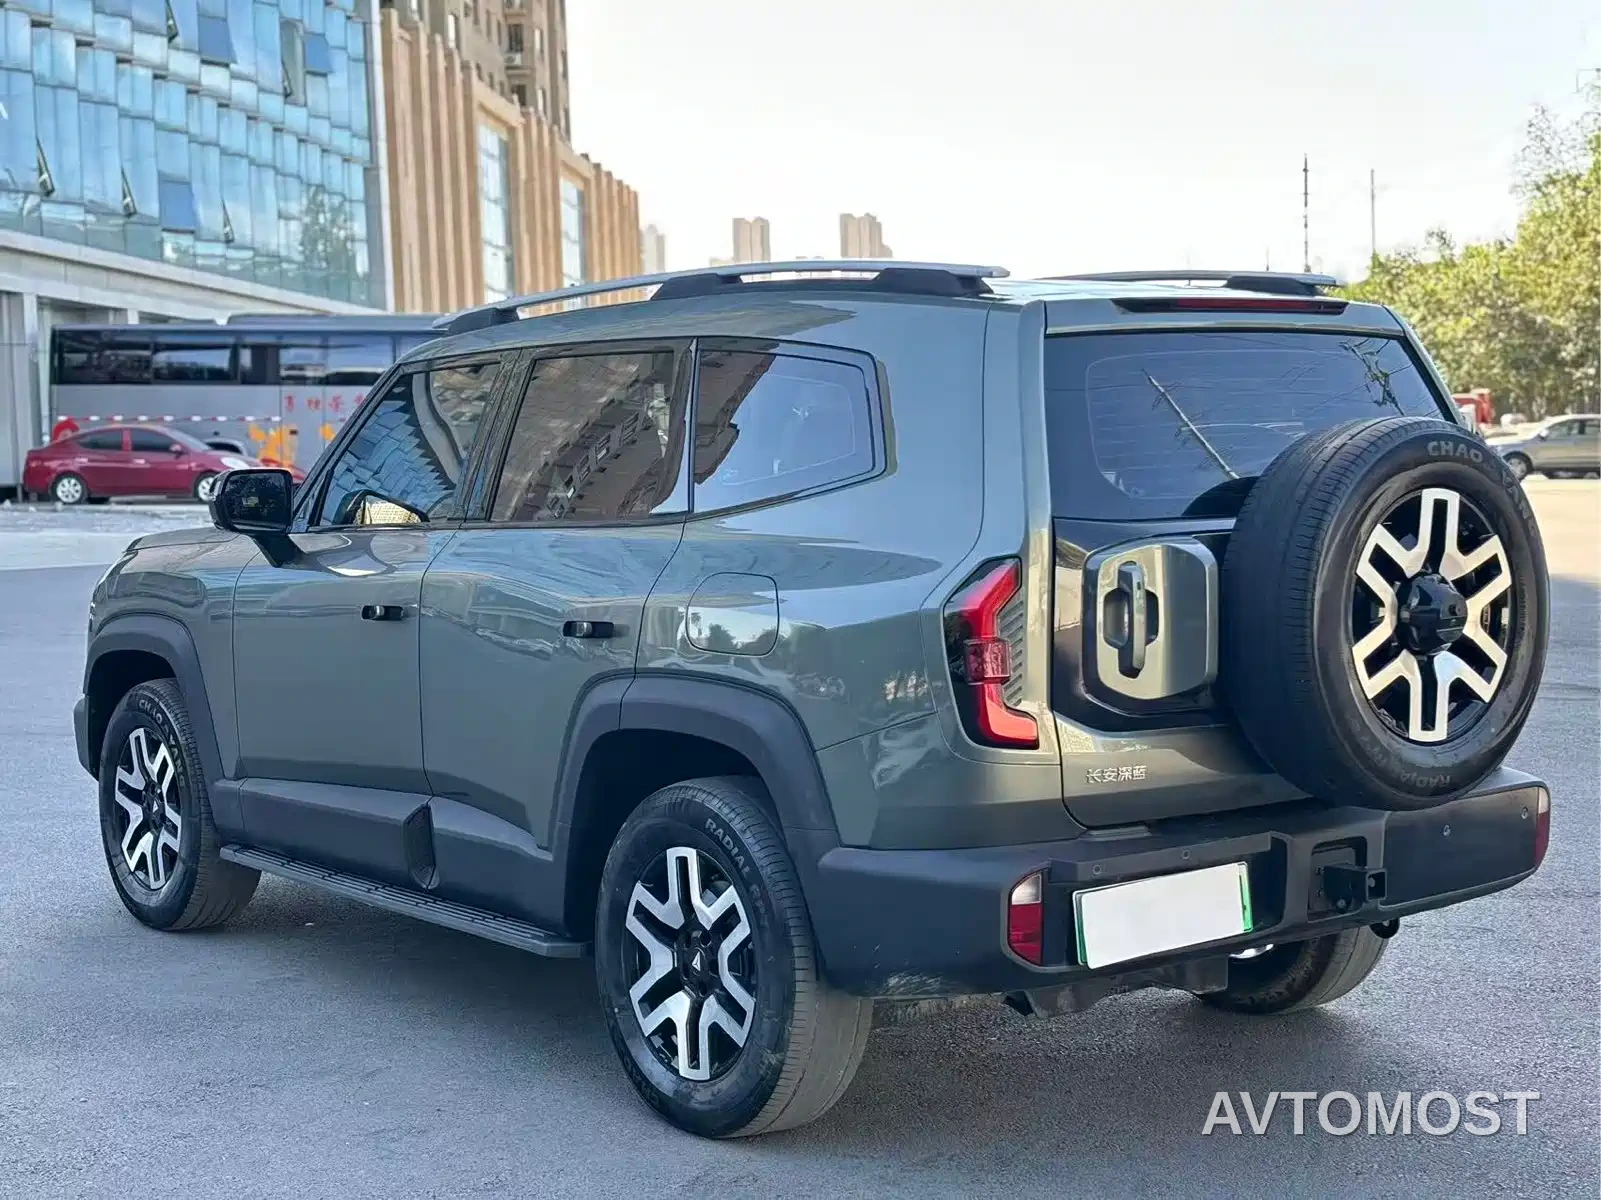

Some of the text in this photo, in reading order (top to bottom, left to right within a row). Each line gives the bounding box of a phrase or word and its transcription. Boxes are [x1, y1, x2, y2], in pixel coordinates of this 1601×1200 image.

[1427, 441, 1483, 462] CHAO
[139, 699, 163, 724] CHAO
[1086, 765, 1147, 783] 长安深蓝
[705, 818, 750, 877] RADIAL
